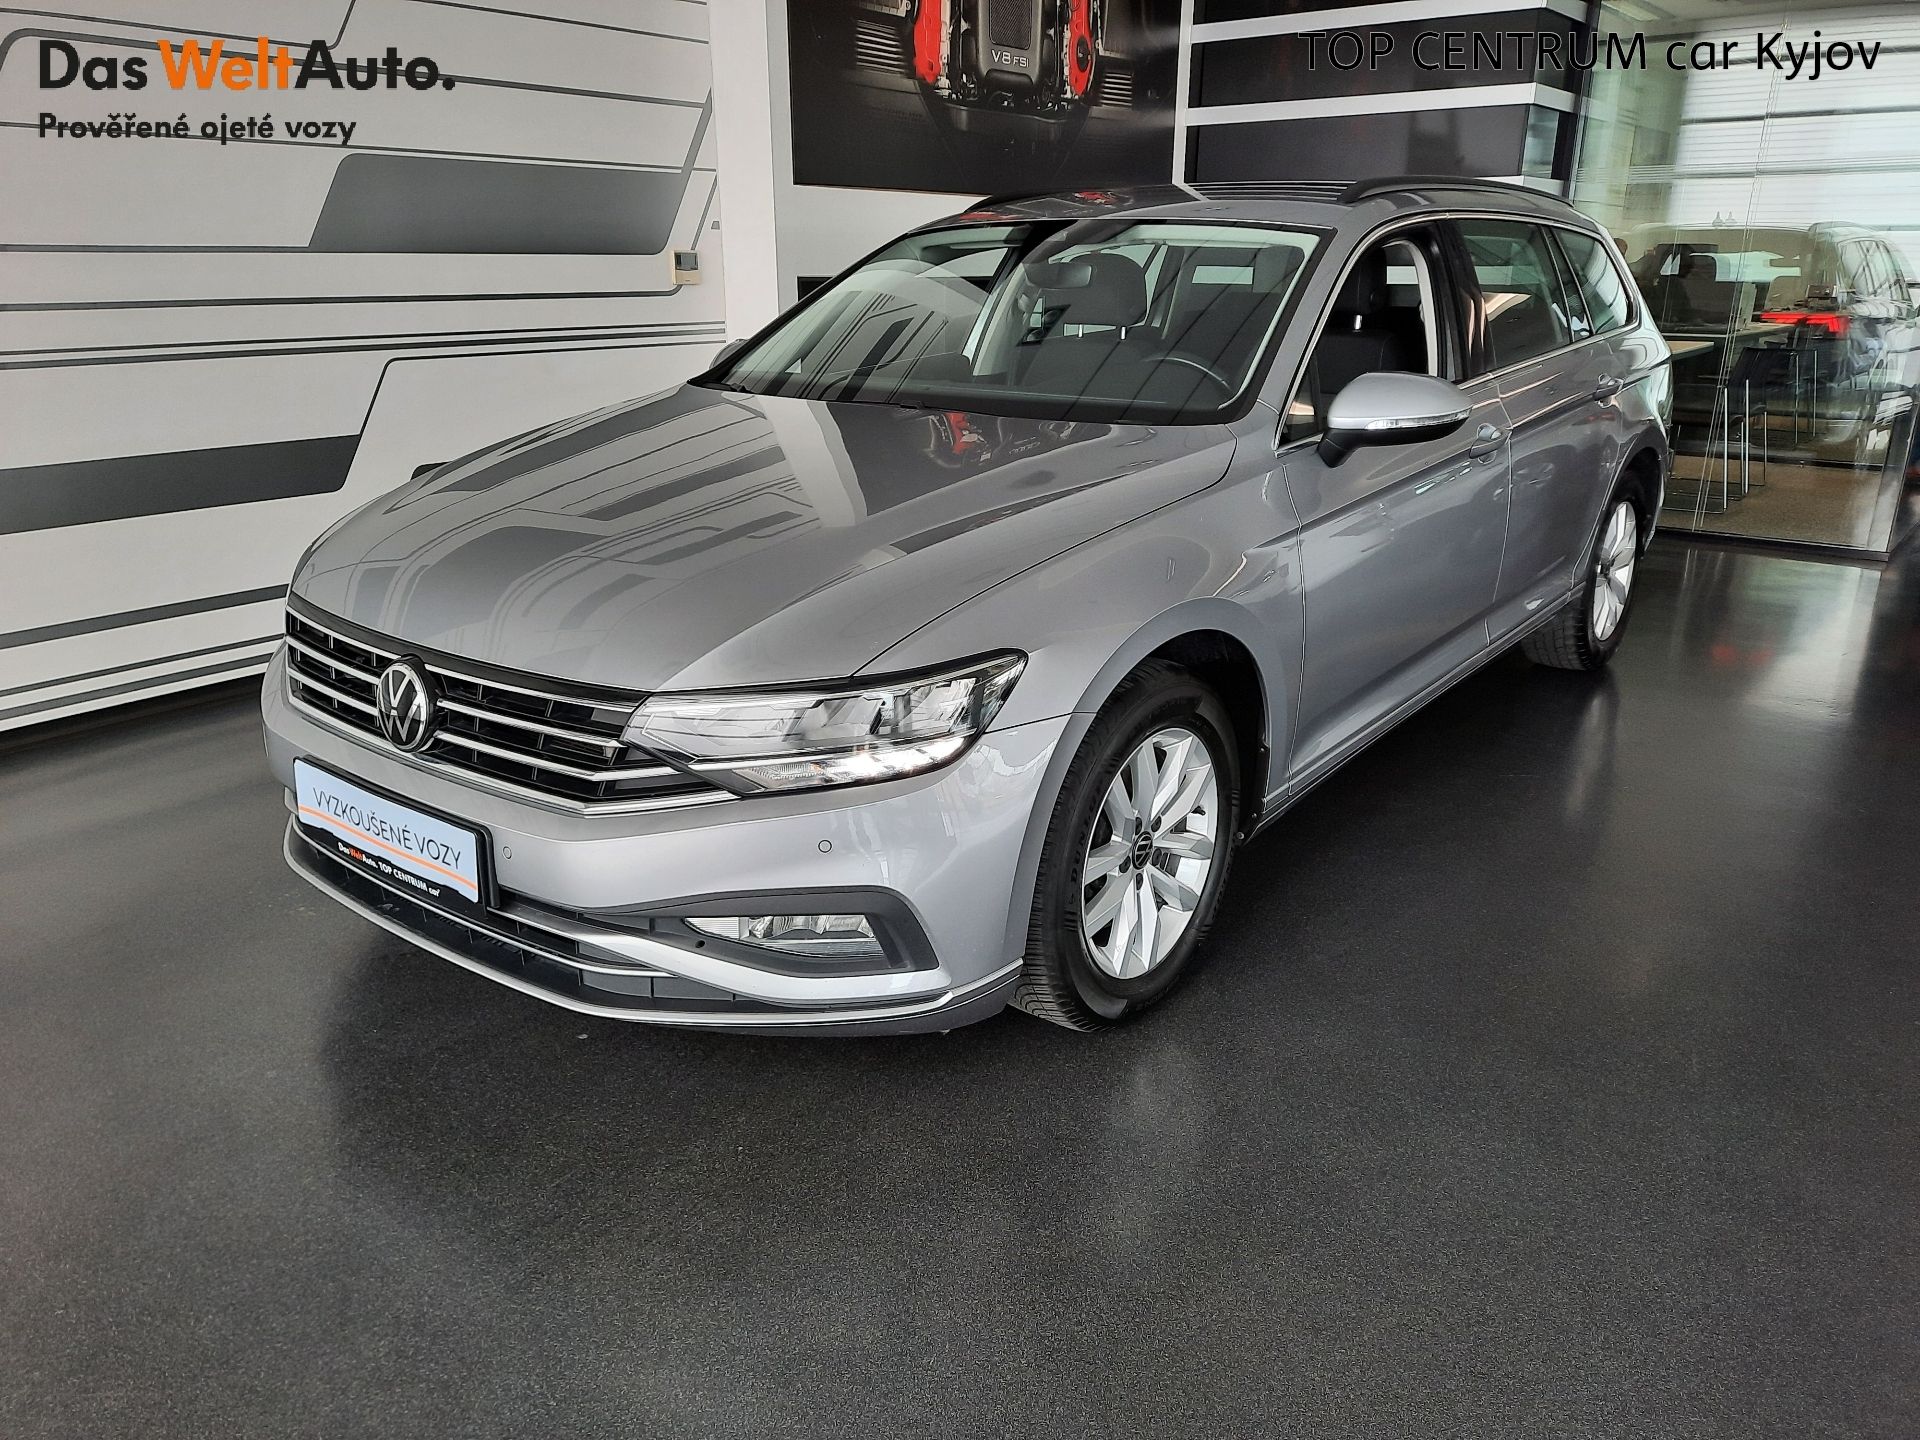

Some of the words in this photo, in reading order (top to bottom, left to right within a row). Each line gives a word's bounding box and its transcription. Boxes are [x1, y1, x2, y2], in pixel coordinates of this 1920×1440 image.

[992, 49, 1011, 65] V8
[1013, 56, 1029, 68] FSI
[313, 787, 413, 852] VYZKOUŠENÉ
[413, 831, 461, 871] VOZY
[378, 861, 393, 875] TOP
[393, 869, 428, 892] CENTRUM
